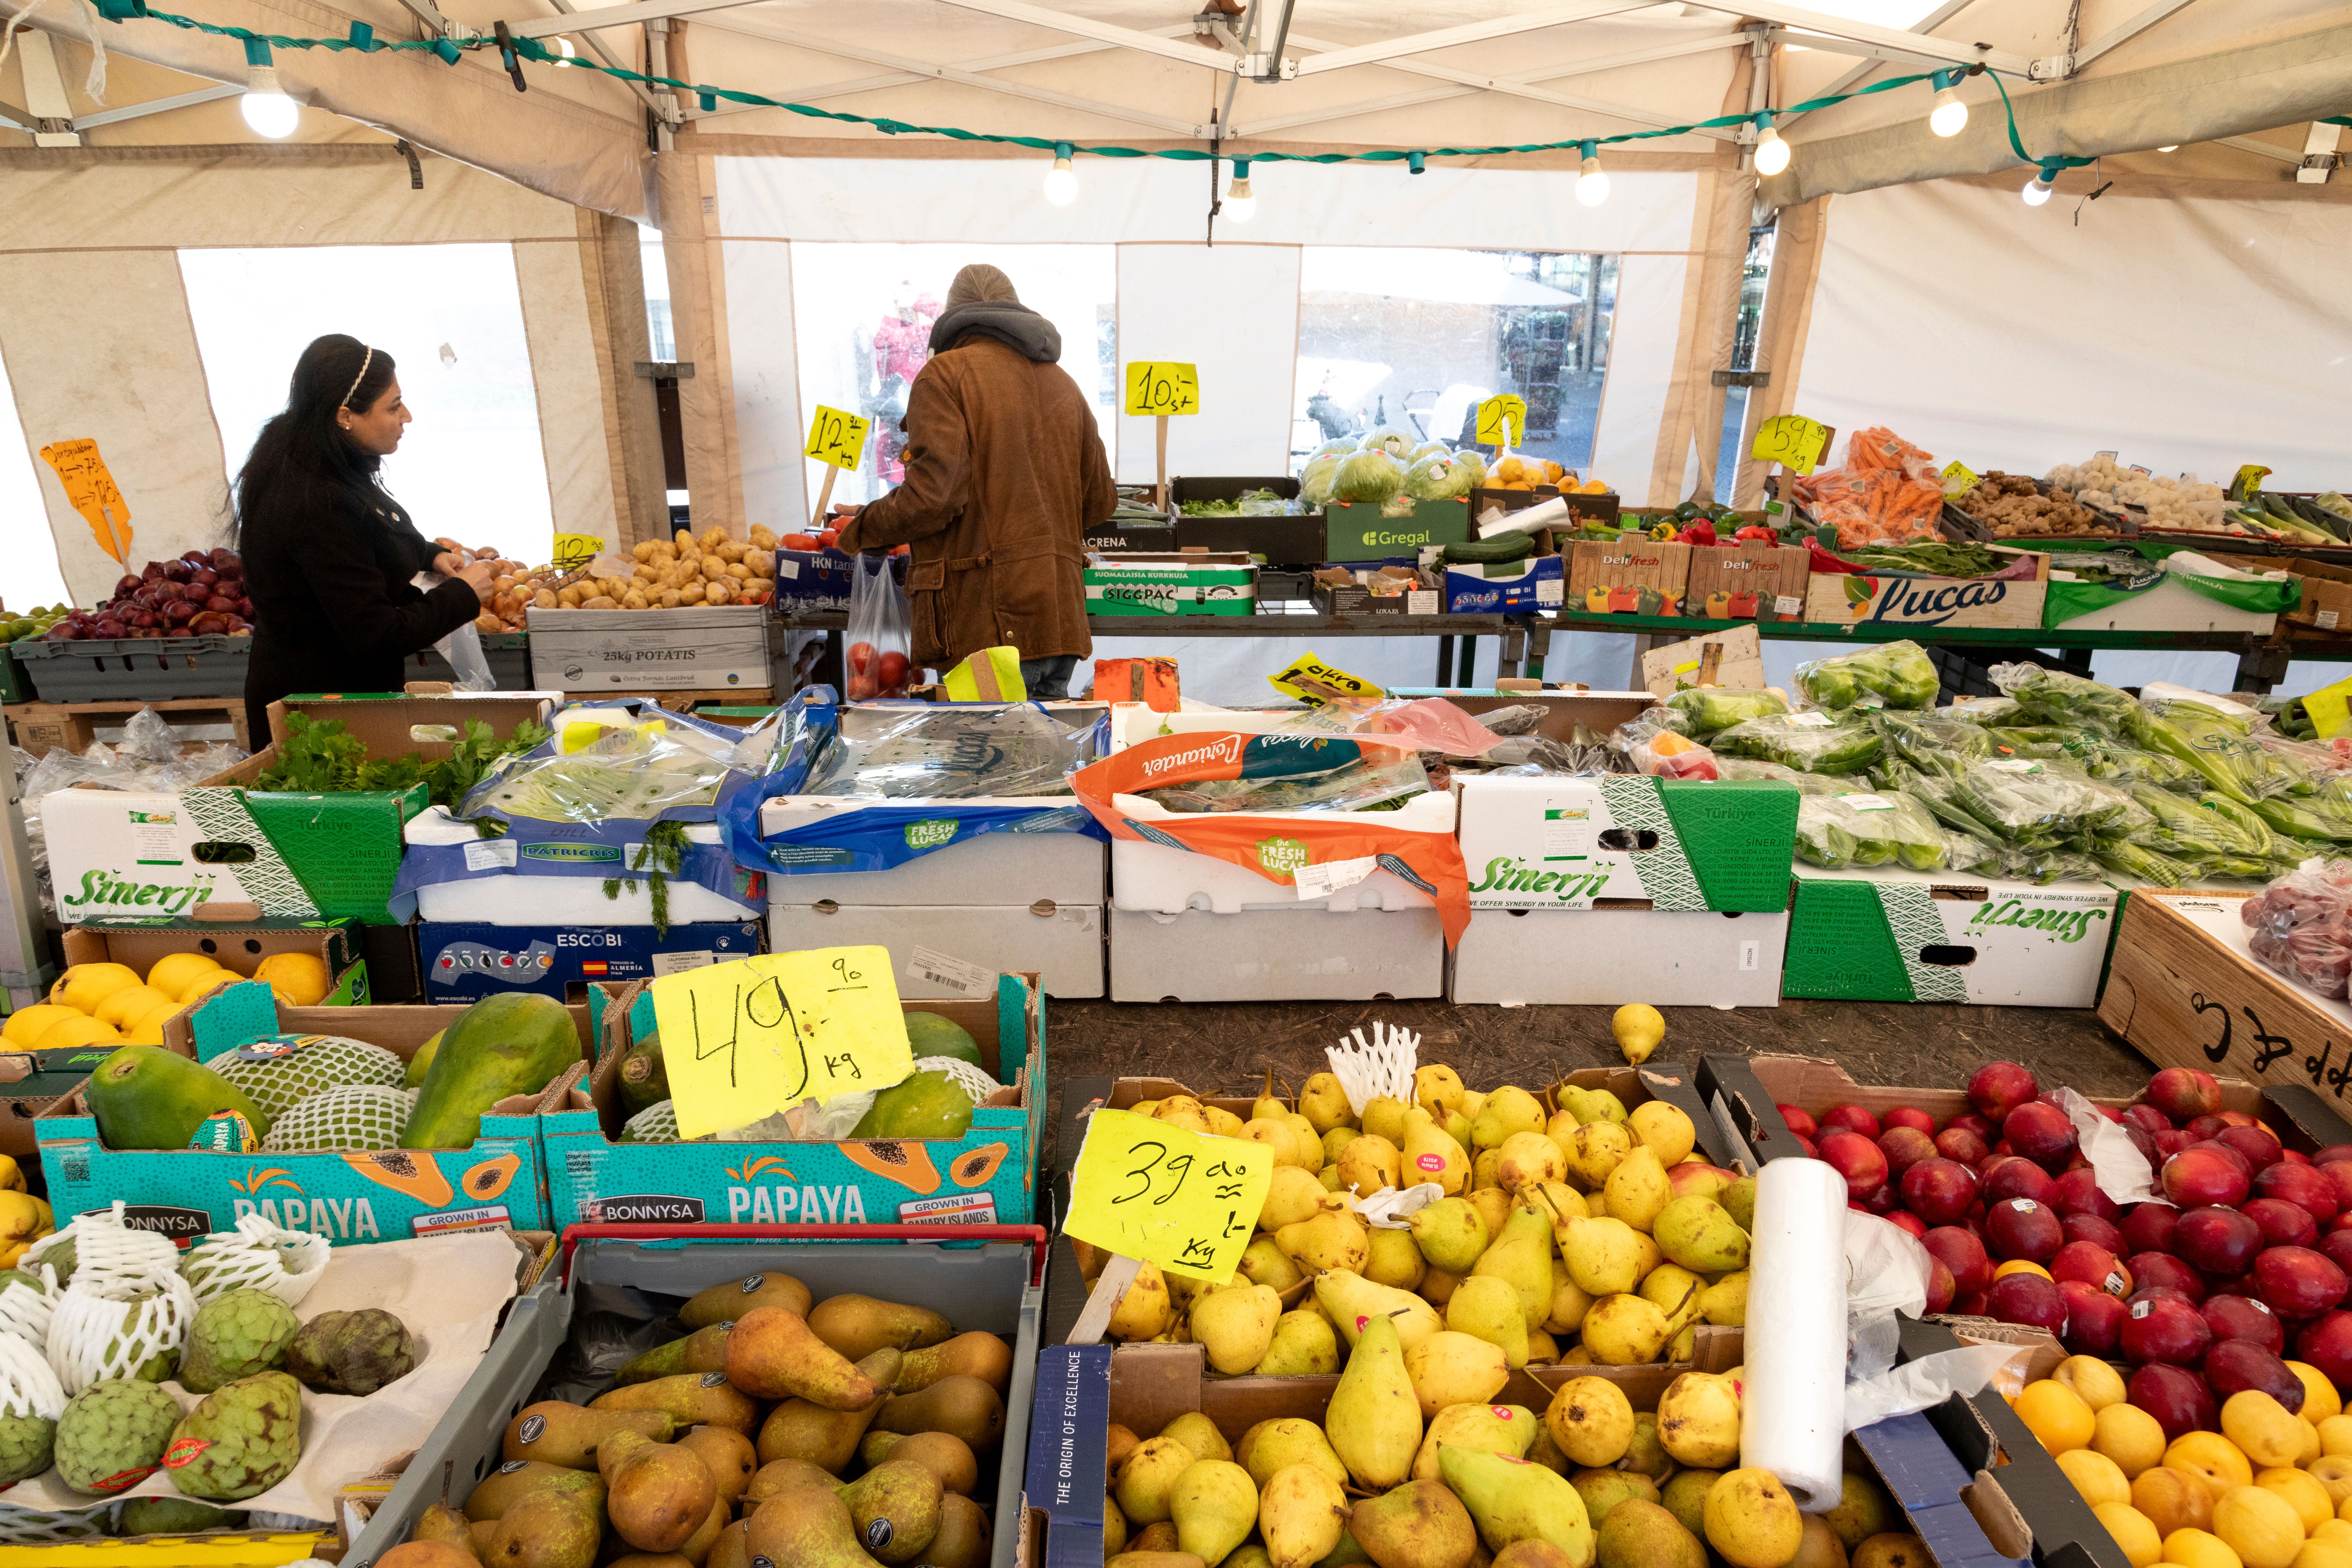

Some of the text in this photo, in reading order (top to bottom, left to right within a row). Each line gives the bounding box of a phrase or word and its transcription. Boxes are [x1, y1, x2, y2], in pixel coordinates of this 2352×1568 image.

[811, 411, 842, 454] 12
[1773, 417, 1807, 454] 59
[1379, 530, 1430, 546] Gregal
[812, 557, 832, 569] HKN
[1107, 587, 1174, 600] SIGGPAC
[1868, 578, 2007, 625] Lucas
[604, 650, 696, 663] 25kg POTATIS
[1307, 665, 1361, 691] okra
[1142, 734, 1242, 776] Coriander
[1563, 810, 1588, 819] Sinerji
[1705, 807, 1757, 821] Türkiye
[911, 823, 955, 837] FRESH
[911, 832, 952, 845] LUCAS
[1276, 839, 1289, 847] the
[1745, 837, 1785, 847] SİNERJİ
[527, 847, 616, 857] PATRICRIS
[1261, 846, 1305, 860] FRESH
[1263, 855, 1305, 871] LUCAS
[1468, 857, 1616, 901] Sinerji
[64, 868, 217, 914] Sinerji
[1963, 899, 2107, 943] Sinerji
[557, 934, 622, 947] ESCOBI
[1798, 946, 1837, 956] SİNERJİ
[824, 1054, 861, 1078] kg
[1111, 1141, 1196, 1206] 39
[727, 1185, 866, 1224] PAPAYA
[915, 1196, 974, 1213] GROWN IN
[428, 1210, 490, 1225] GROWN IN
[607, 1204, 694, 1221] BONNYSA
[948, 1211, 989, 1225] ISLANDS
[123, 1216, 201, 1230] ONNYSA
[1056, 1351, 1081, 1505] THE ORIGIN OF EXCELLENCE
